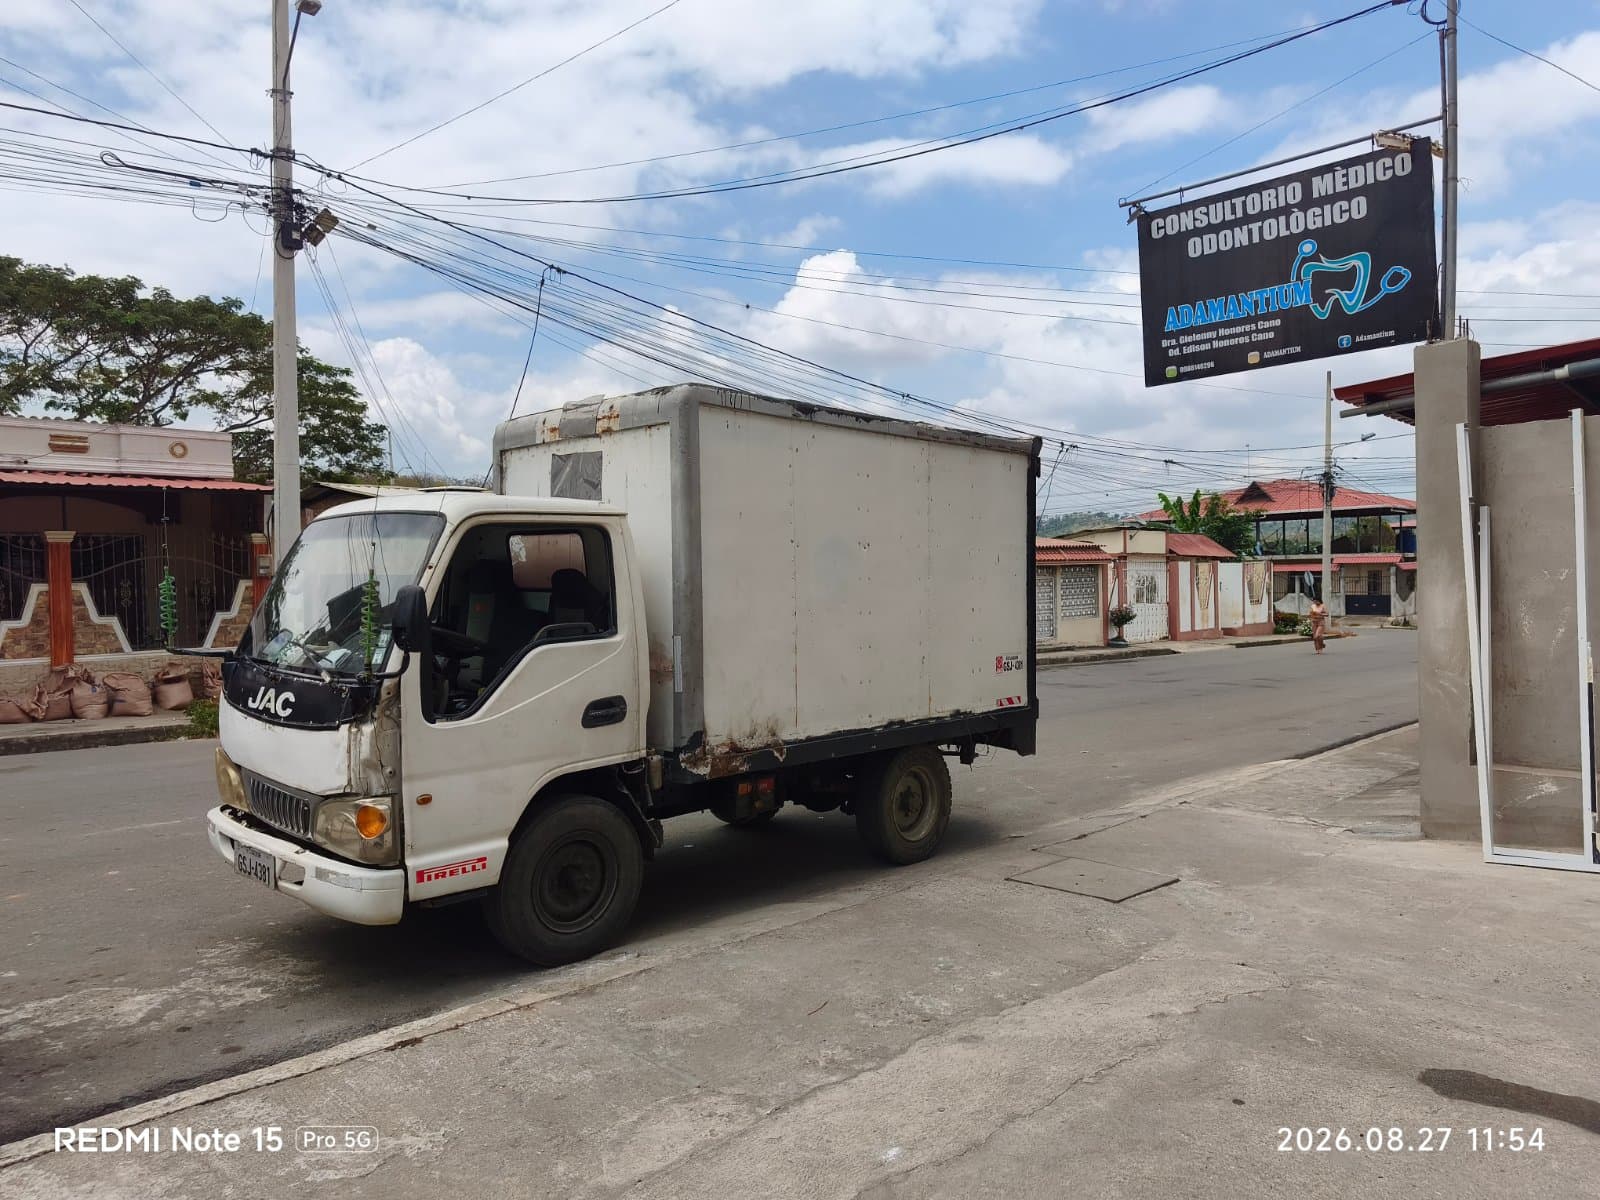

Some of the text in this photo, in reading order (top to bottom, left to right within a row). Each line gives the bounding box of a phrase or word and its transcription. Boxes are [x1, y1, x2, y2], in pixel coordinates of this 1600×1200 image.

[1150, 152, 1412, 239] CONSULTORIO MÈDICO
[1187, 196, 1367, 258] ODONTOLÒGICO
[1165, 279, 1312, 332] ADAMANTIUM
[1161, 339, 1178, 348] Dra.
[1218, 323, 1256, 337] Honores
[1257, 318, 1281, 330] Cano
[1182, 342, 1211, 355] Edison
[1251, 330, 1275, 342] Cano
[248, 686, 296, 718] JAC
[415, 856, 487, 883] PIRELLI
